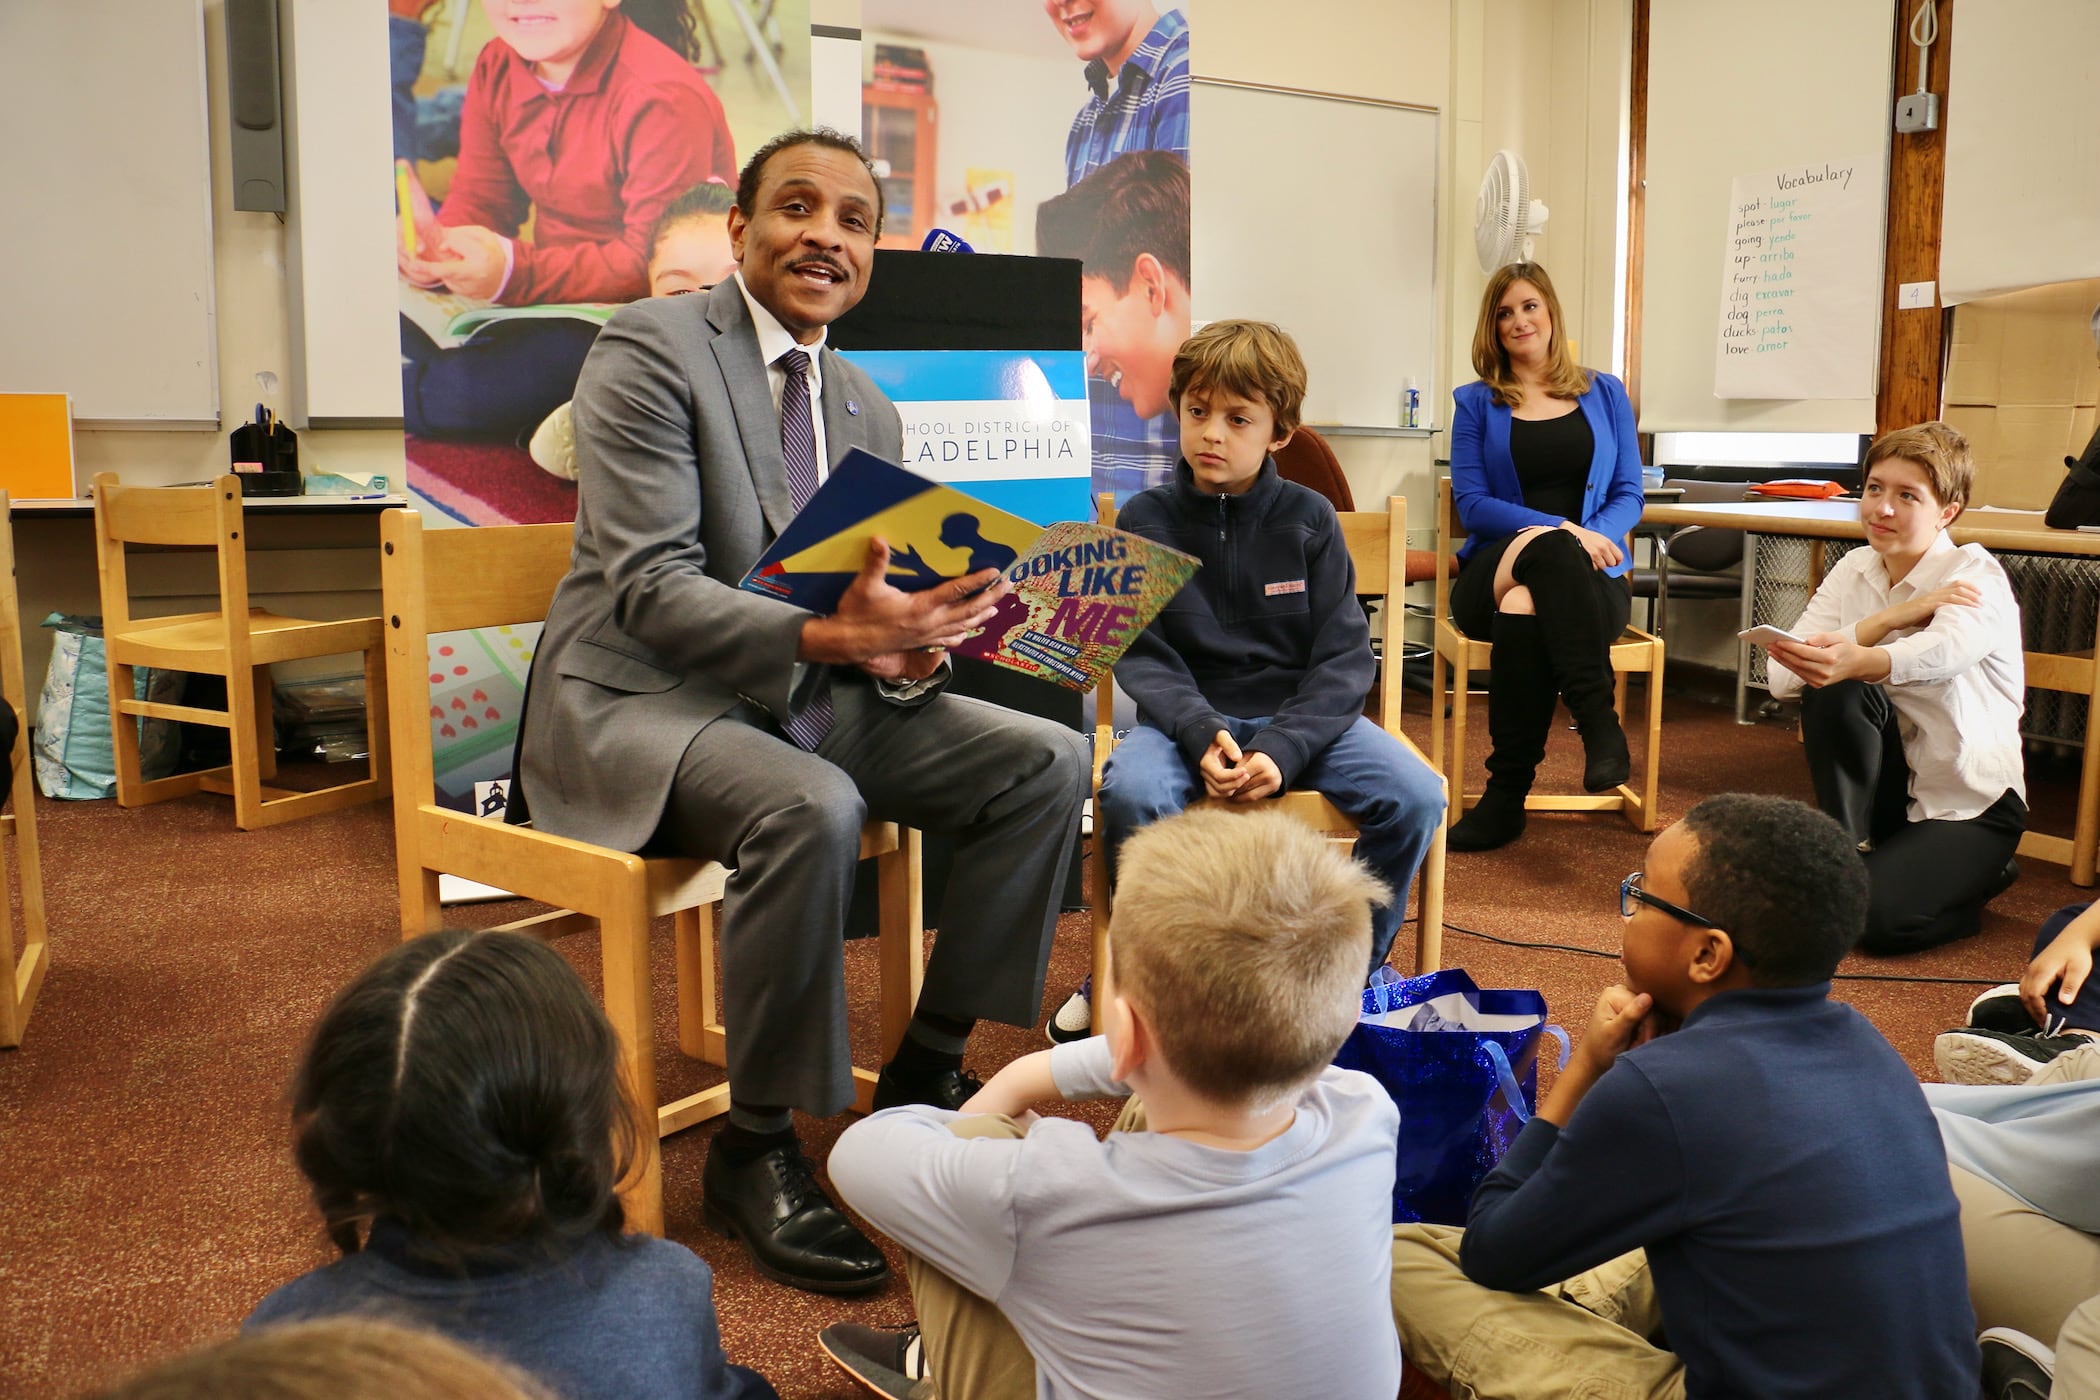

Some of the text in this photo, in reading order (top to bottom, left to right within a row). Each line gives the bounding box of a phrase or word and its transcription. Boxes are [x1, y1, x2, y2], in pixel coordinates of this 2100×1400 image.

[1776, 163, 1853, 191] Vocabulary
[1738, 197, 1760, 218] spot
[1736, 219, 1765, 236] please
[1734, 236, 1762, 251] going
[1729, 286, 1749, 308] dig
[1727, 304, 1749, 326] dog
[1723, 324, 1757, 338] ducks
[1726, 342, 1749, 355] love
[1052, 420, 1071, 433] OF
[1057, 565, 1146, 598] LIKE
[1045, 597, 1137, 647] ME
[990, 653, 1038, 671] SCHOLASTIC
